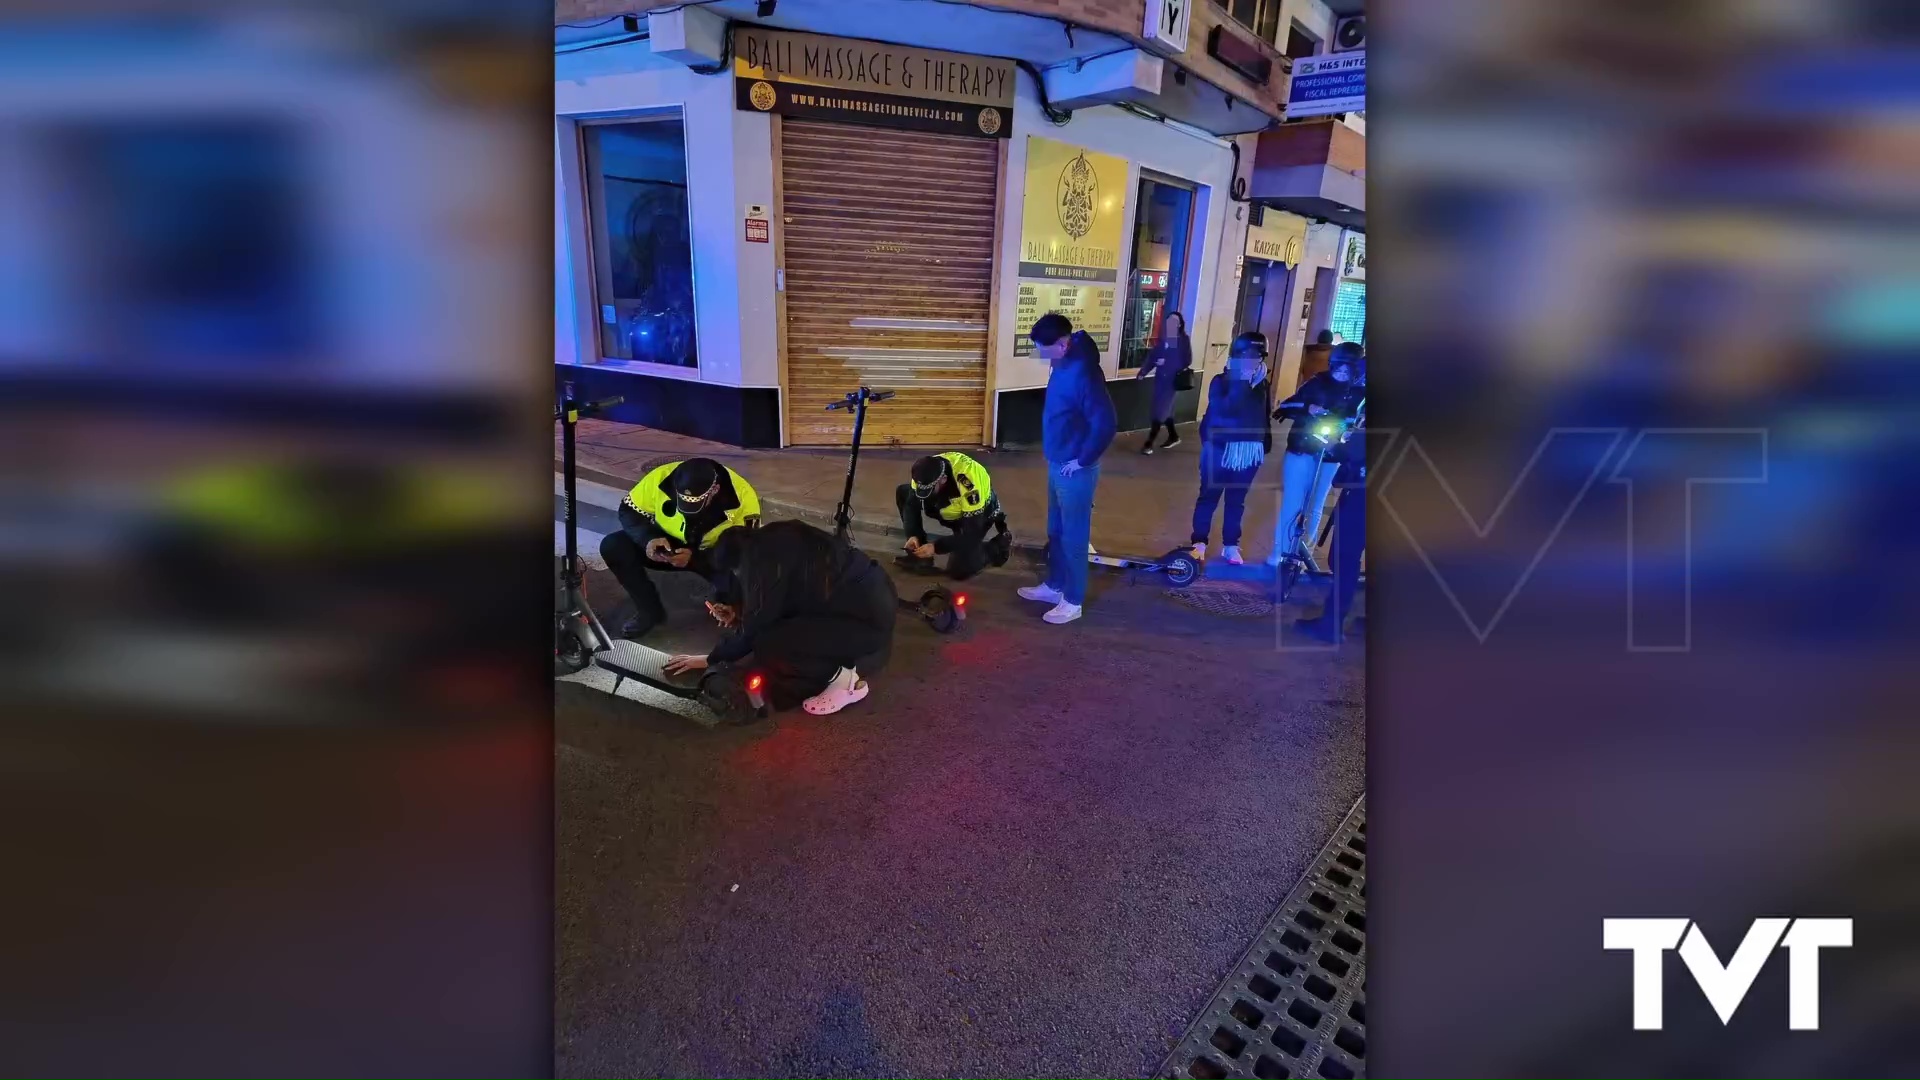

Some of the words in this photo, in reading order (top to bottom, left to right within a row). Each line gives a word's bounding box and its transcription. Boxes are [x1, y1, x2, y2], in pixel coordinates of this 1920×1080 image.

[748, 36, 792, 74] BALI
[804, 44, 892, 87] MASSAGE
[902, 56, 913, 89] &
[923, 58, 1008, 99] THERAPY
[1028, 242, 1044, 262] BALI
[1047, 244, 1079, 265] MASSAGE
